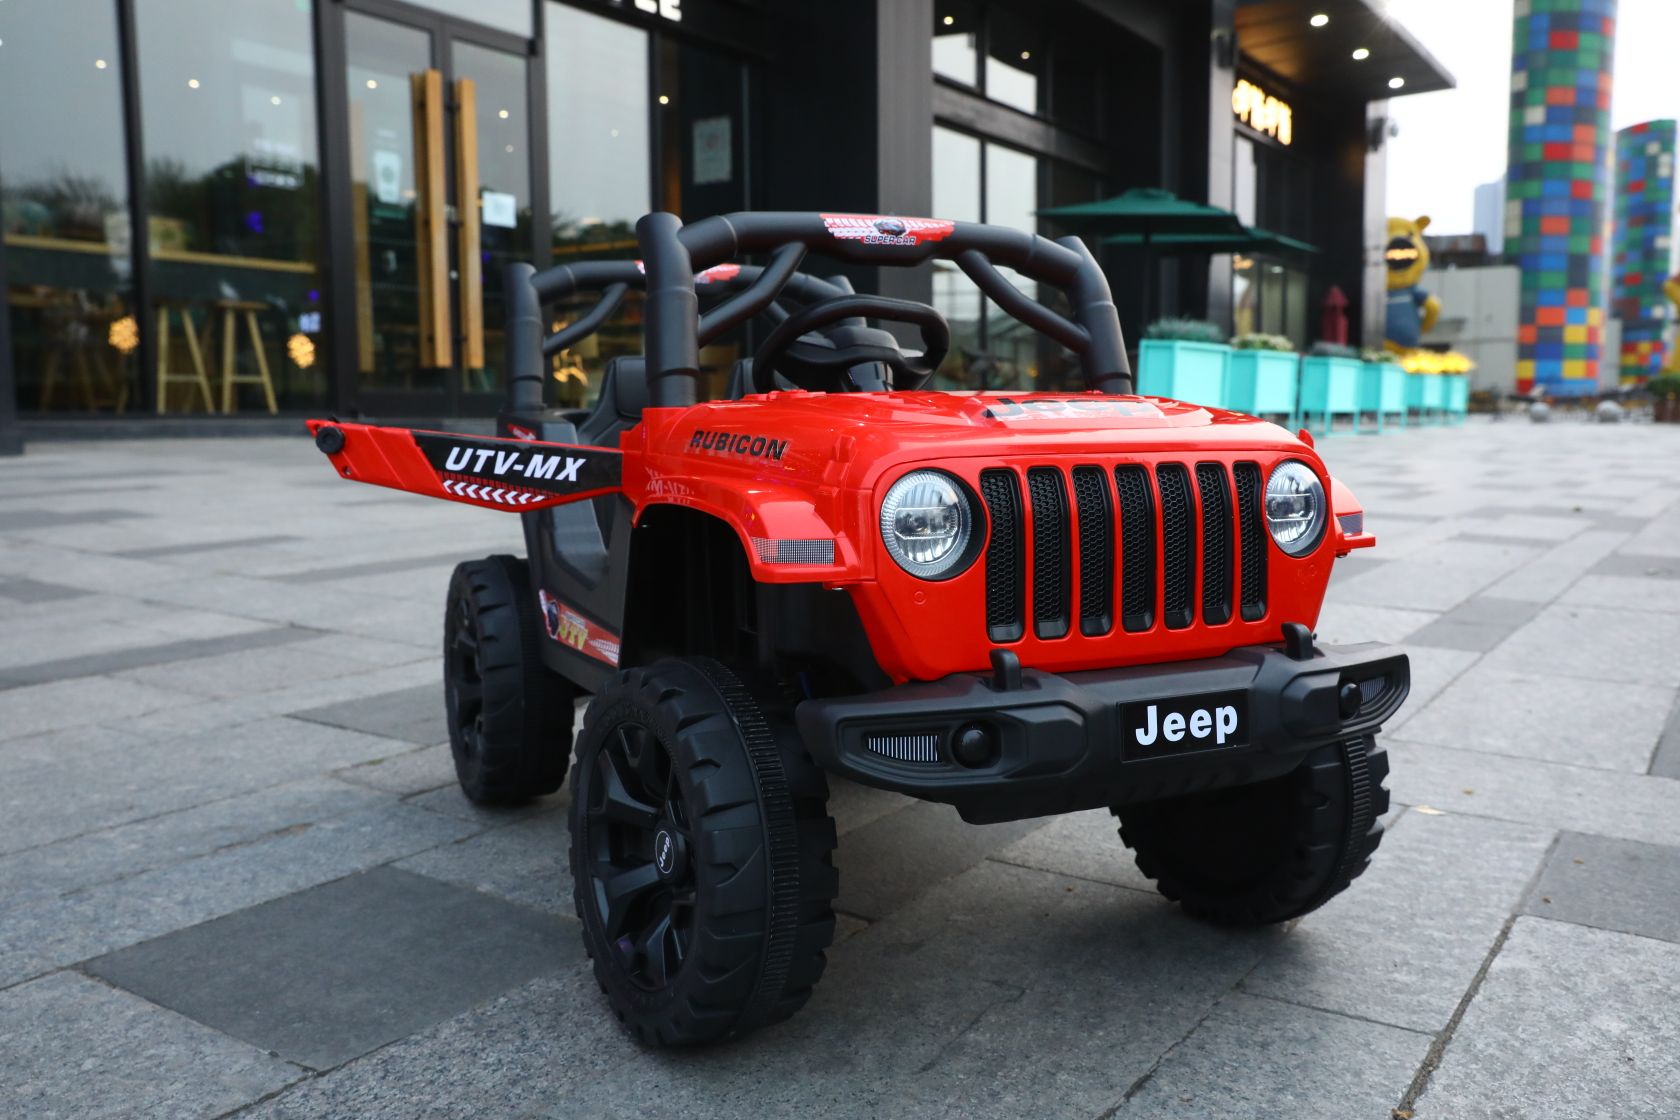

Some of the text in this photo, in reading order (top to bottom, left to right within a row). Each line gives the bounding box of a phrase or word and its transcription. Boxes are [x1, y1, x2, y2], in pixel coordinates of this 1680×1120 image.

[863, 234, 917, 246] SUPER CAR
[690, 430, 788, 461] RUBICON
[445, 446, 587, 482] UTV-MX
[1135, 704, 1238, 746] Jeep
[659, 836, 670, 868] Jeep
